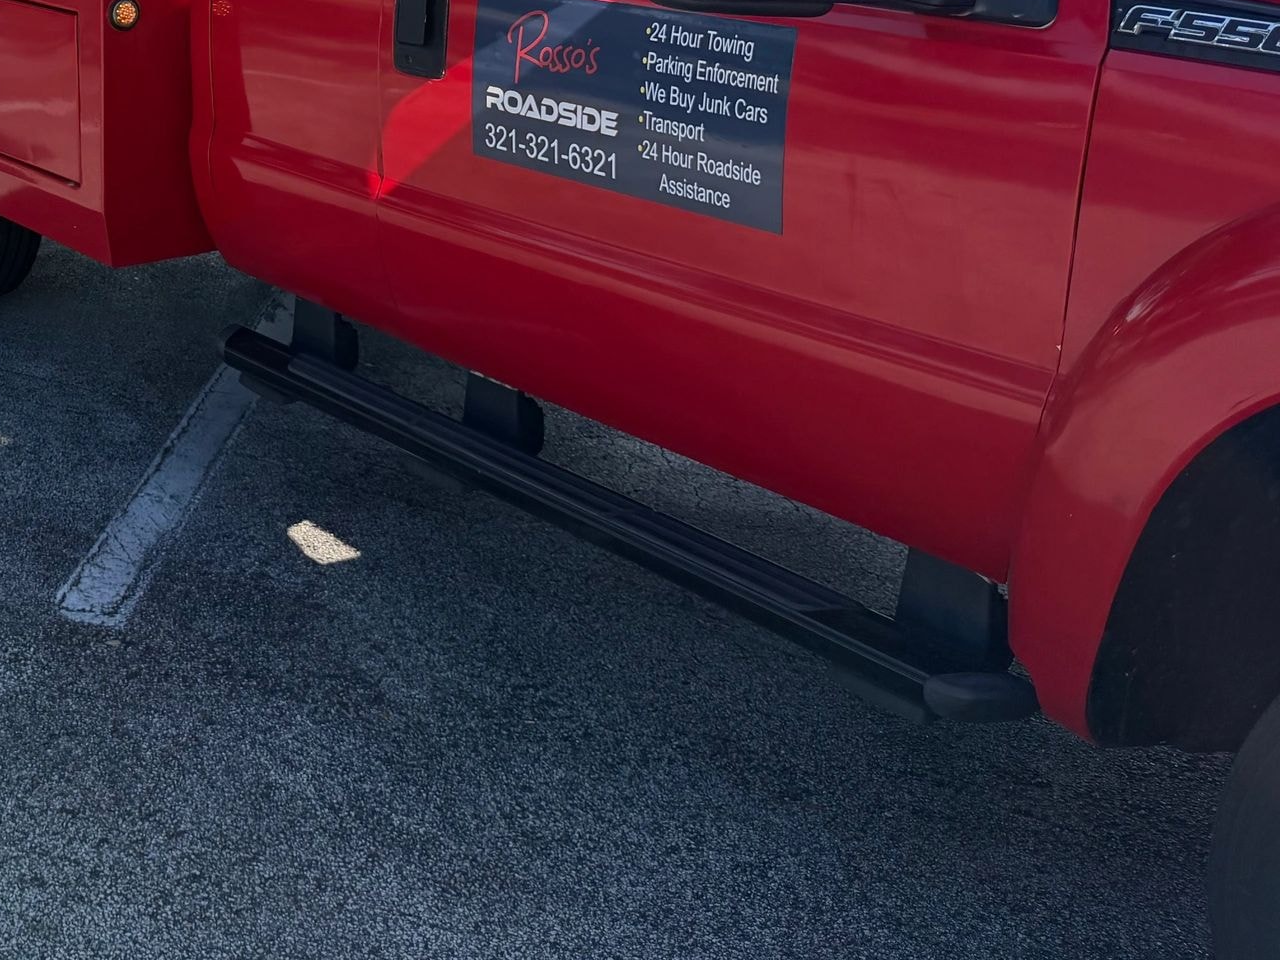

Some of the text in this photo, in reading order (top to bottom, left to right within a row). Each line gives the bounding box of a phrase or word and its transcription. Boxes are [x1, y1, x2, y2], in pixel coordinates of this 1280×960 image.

[507, 10, 601, 84] Rosso's
[649, 22, 754, 62] 24 Hour Towing
[646, 51, 780, 94] Parking Enforcement
[486, 85, 619, 137] ROADSIDE
[644, 81, 768, 124] We Buy Junk Cars
[643, 110, 705, 142] Transport
[485, 123, 617, 179] 321-321-6321
[642, 140, 761, 186] 24 Hour Roadside
[659, 173, 731, 208] Assistance
